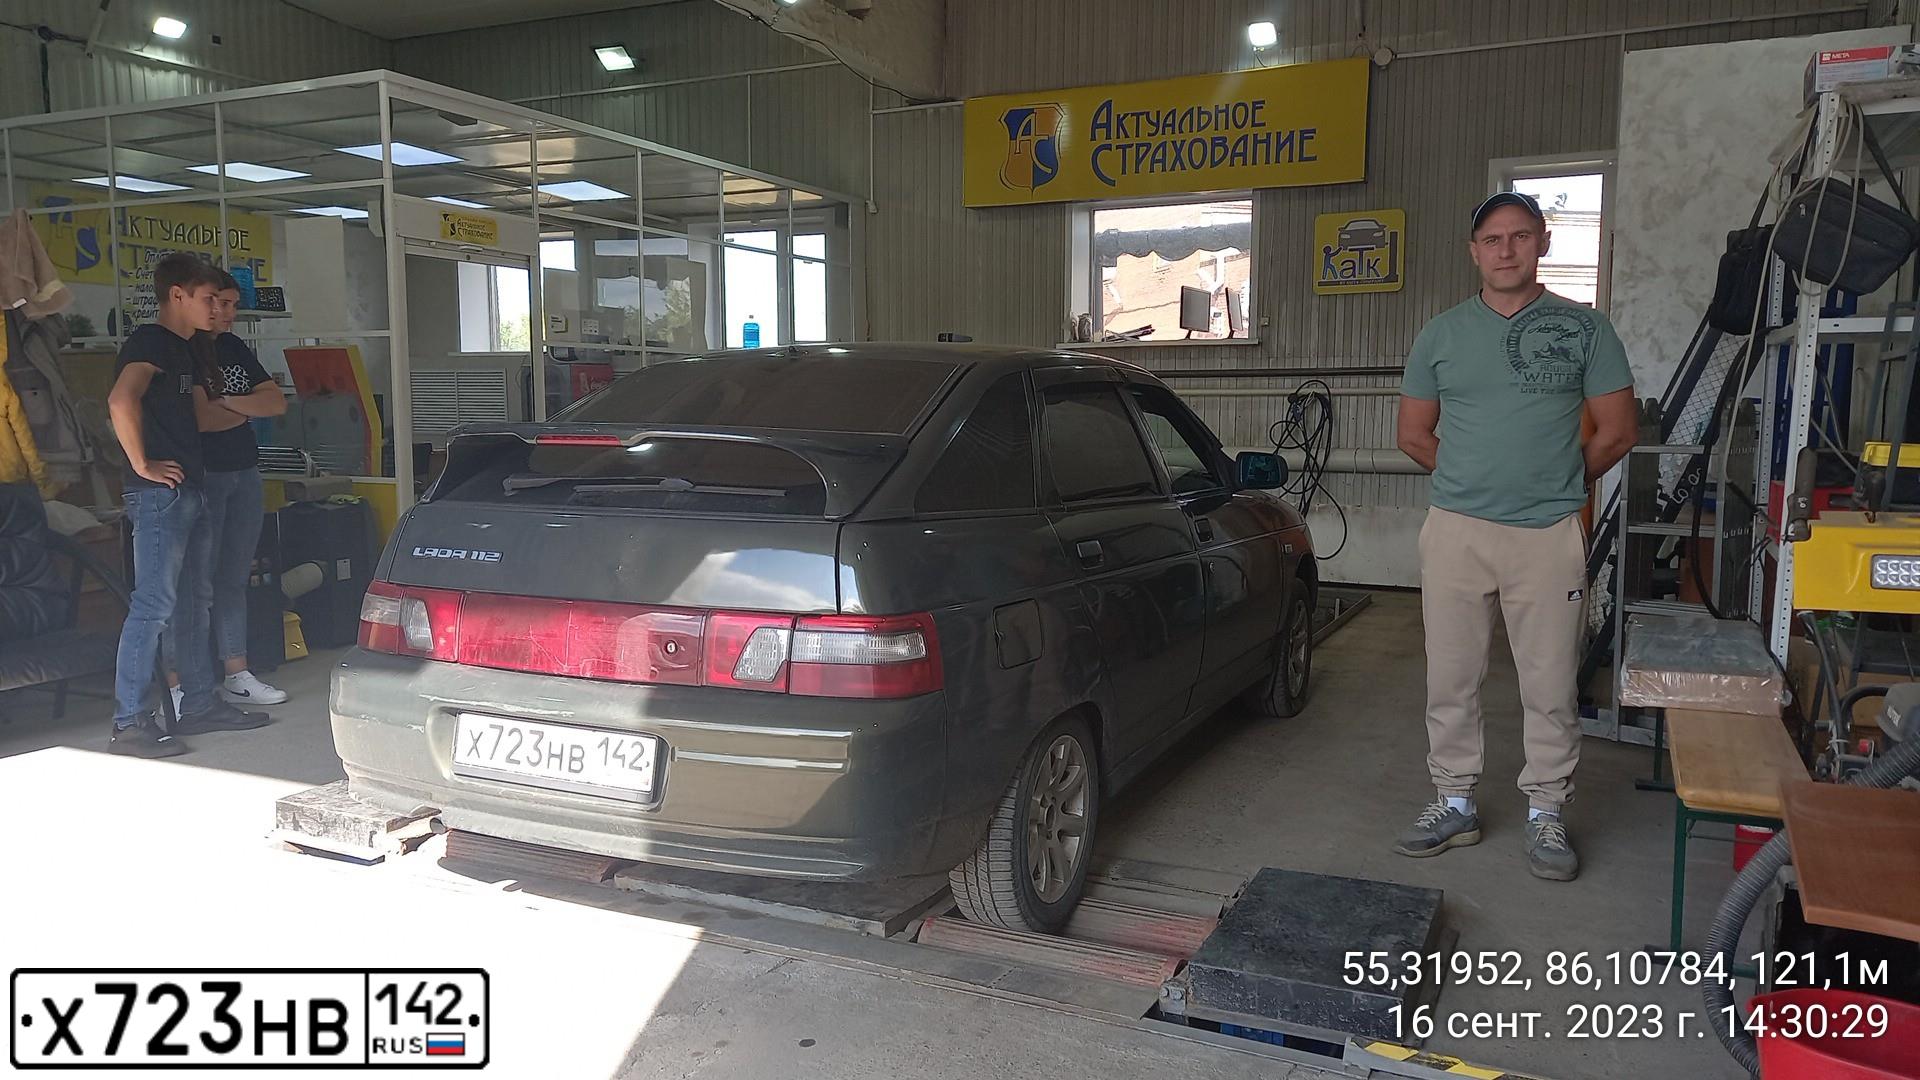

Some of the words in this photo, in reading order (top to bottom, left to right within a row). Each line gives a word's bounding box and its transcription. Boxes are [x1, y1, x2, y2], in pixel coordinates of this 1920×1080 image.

[412, 546, 467, 560] LADA
[470, 550, 501, 563] 112
[597, 736, 646, 772] 142
